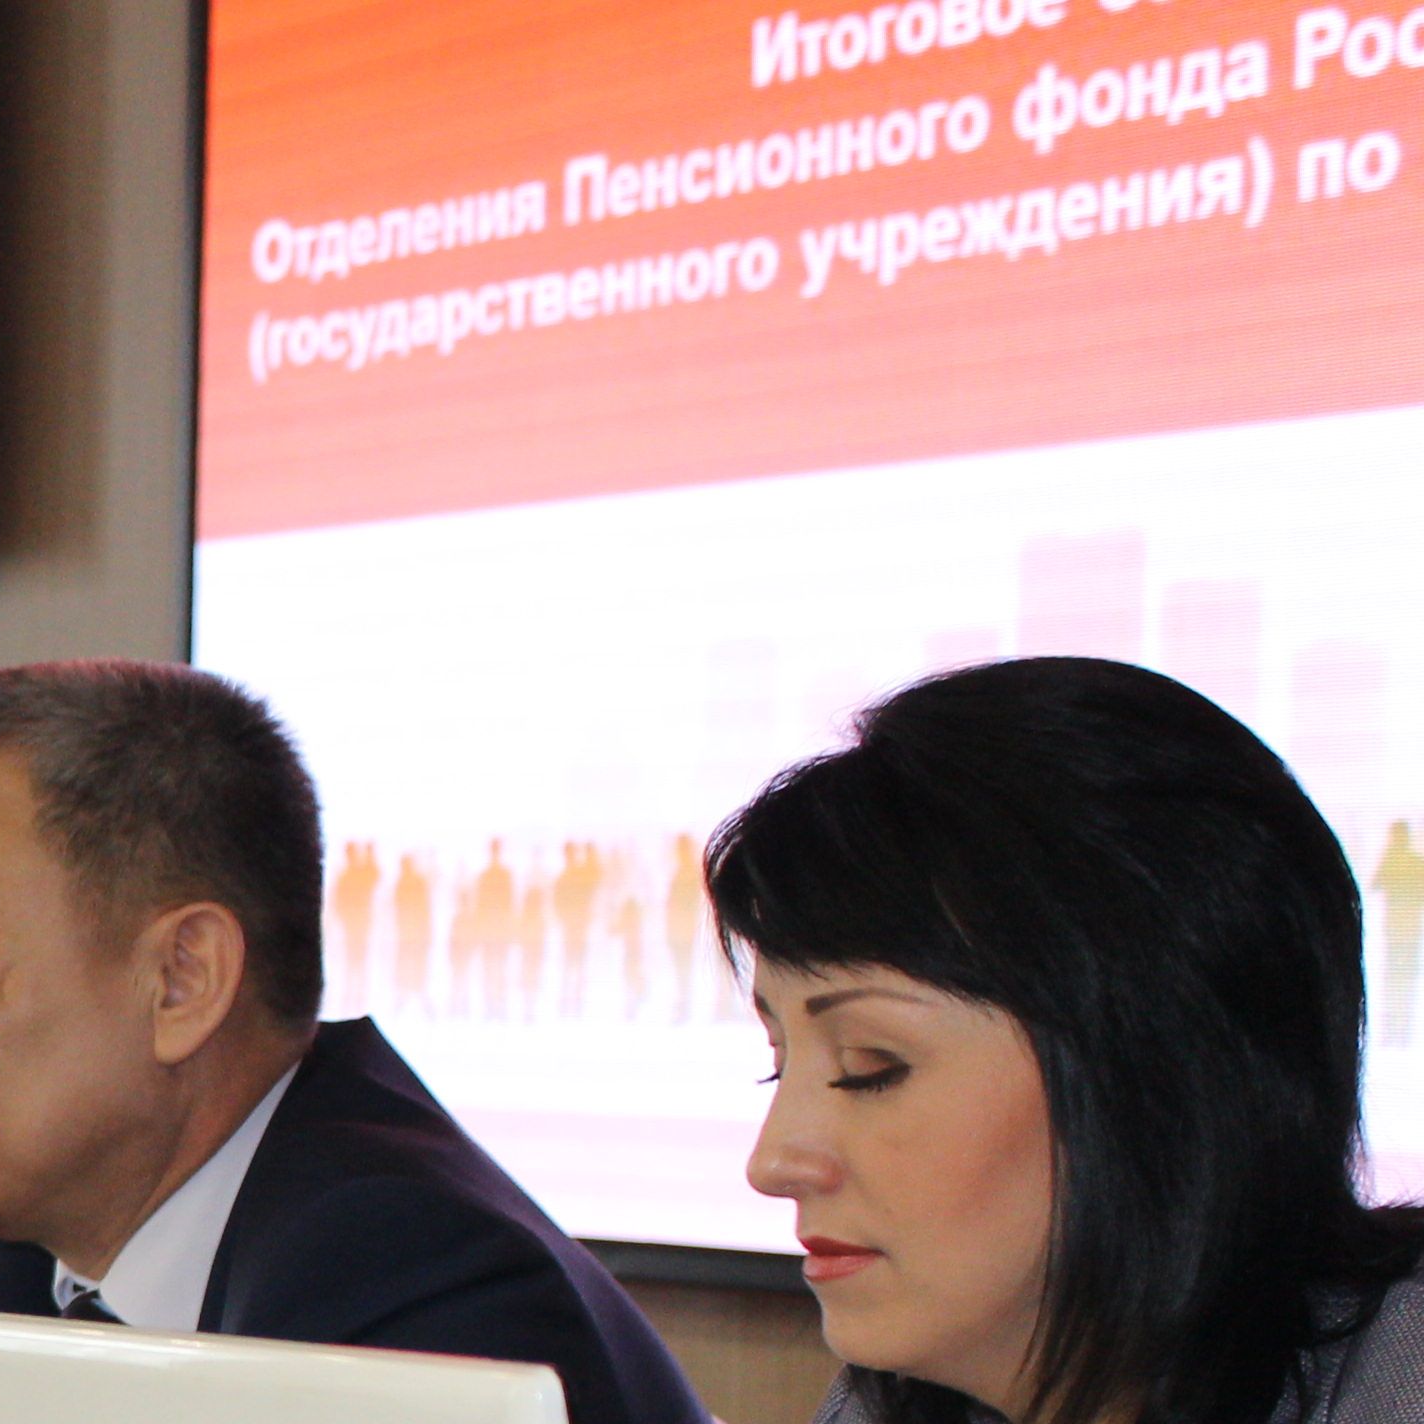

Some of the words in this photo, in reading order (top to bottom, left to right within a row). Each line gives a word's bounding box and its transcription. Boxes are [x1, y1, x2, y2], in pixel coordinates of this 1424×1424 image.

[248, 235, 781, 383] (государственного
[799, 135, 1274, 299] учреждения)
[1296, 129, 1402, 204] по
[251, 180, 548, 284] Отделения
[562, 94, 991, 226] Пенсионного
[1012, 38, 1270, 156] фонда
